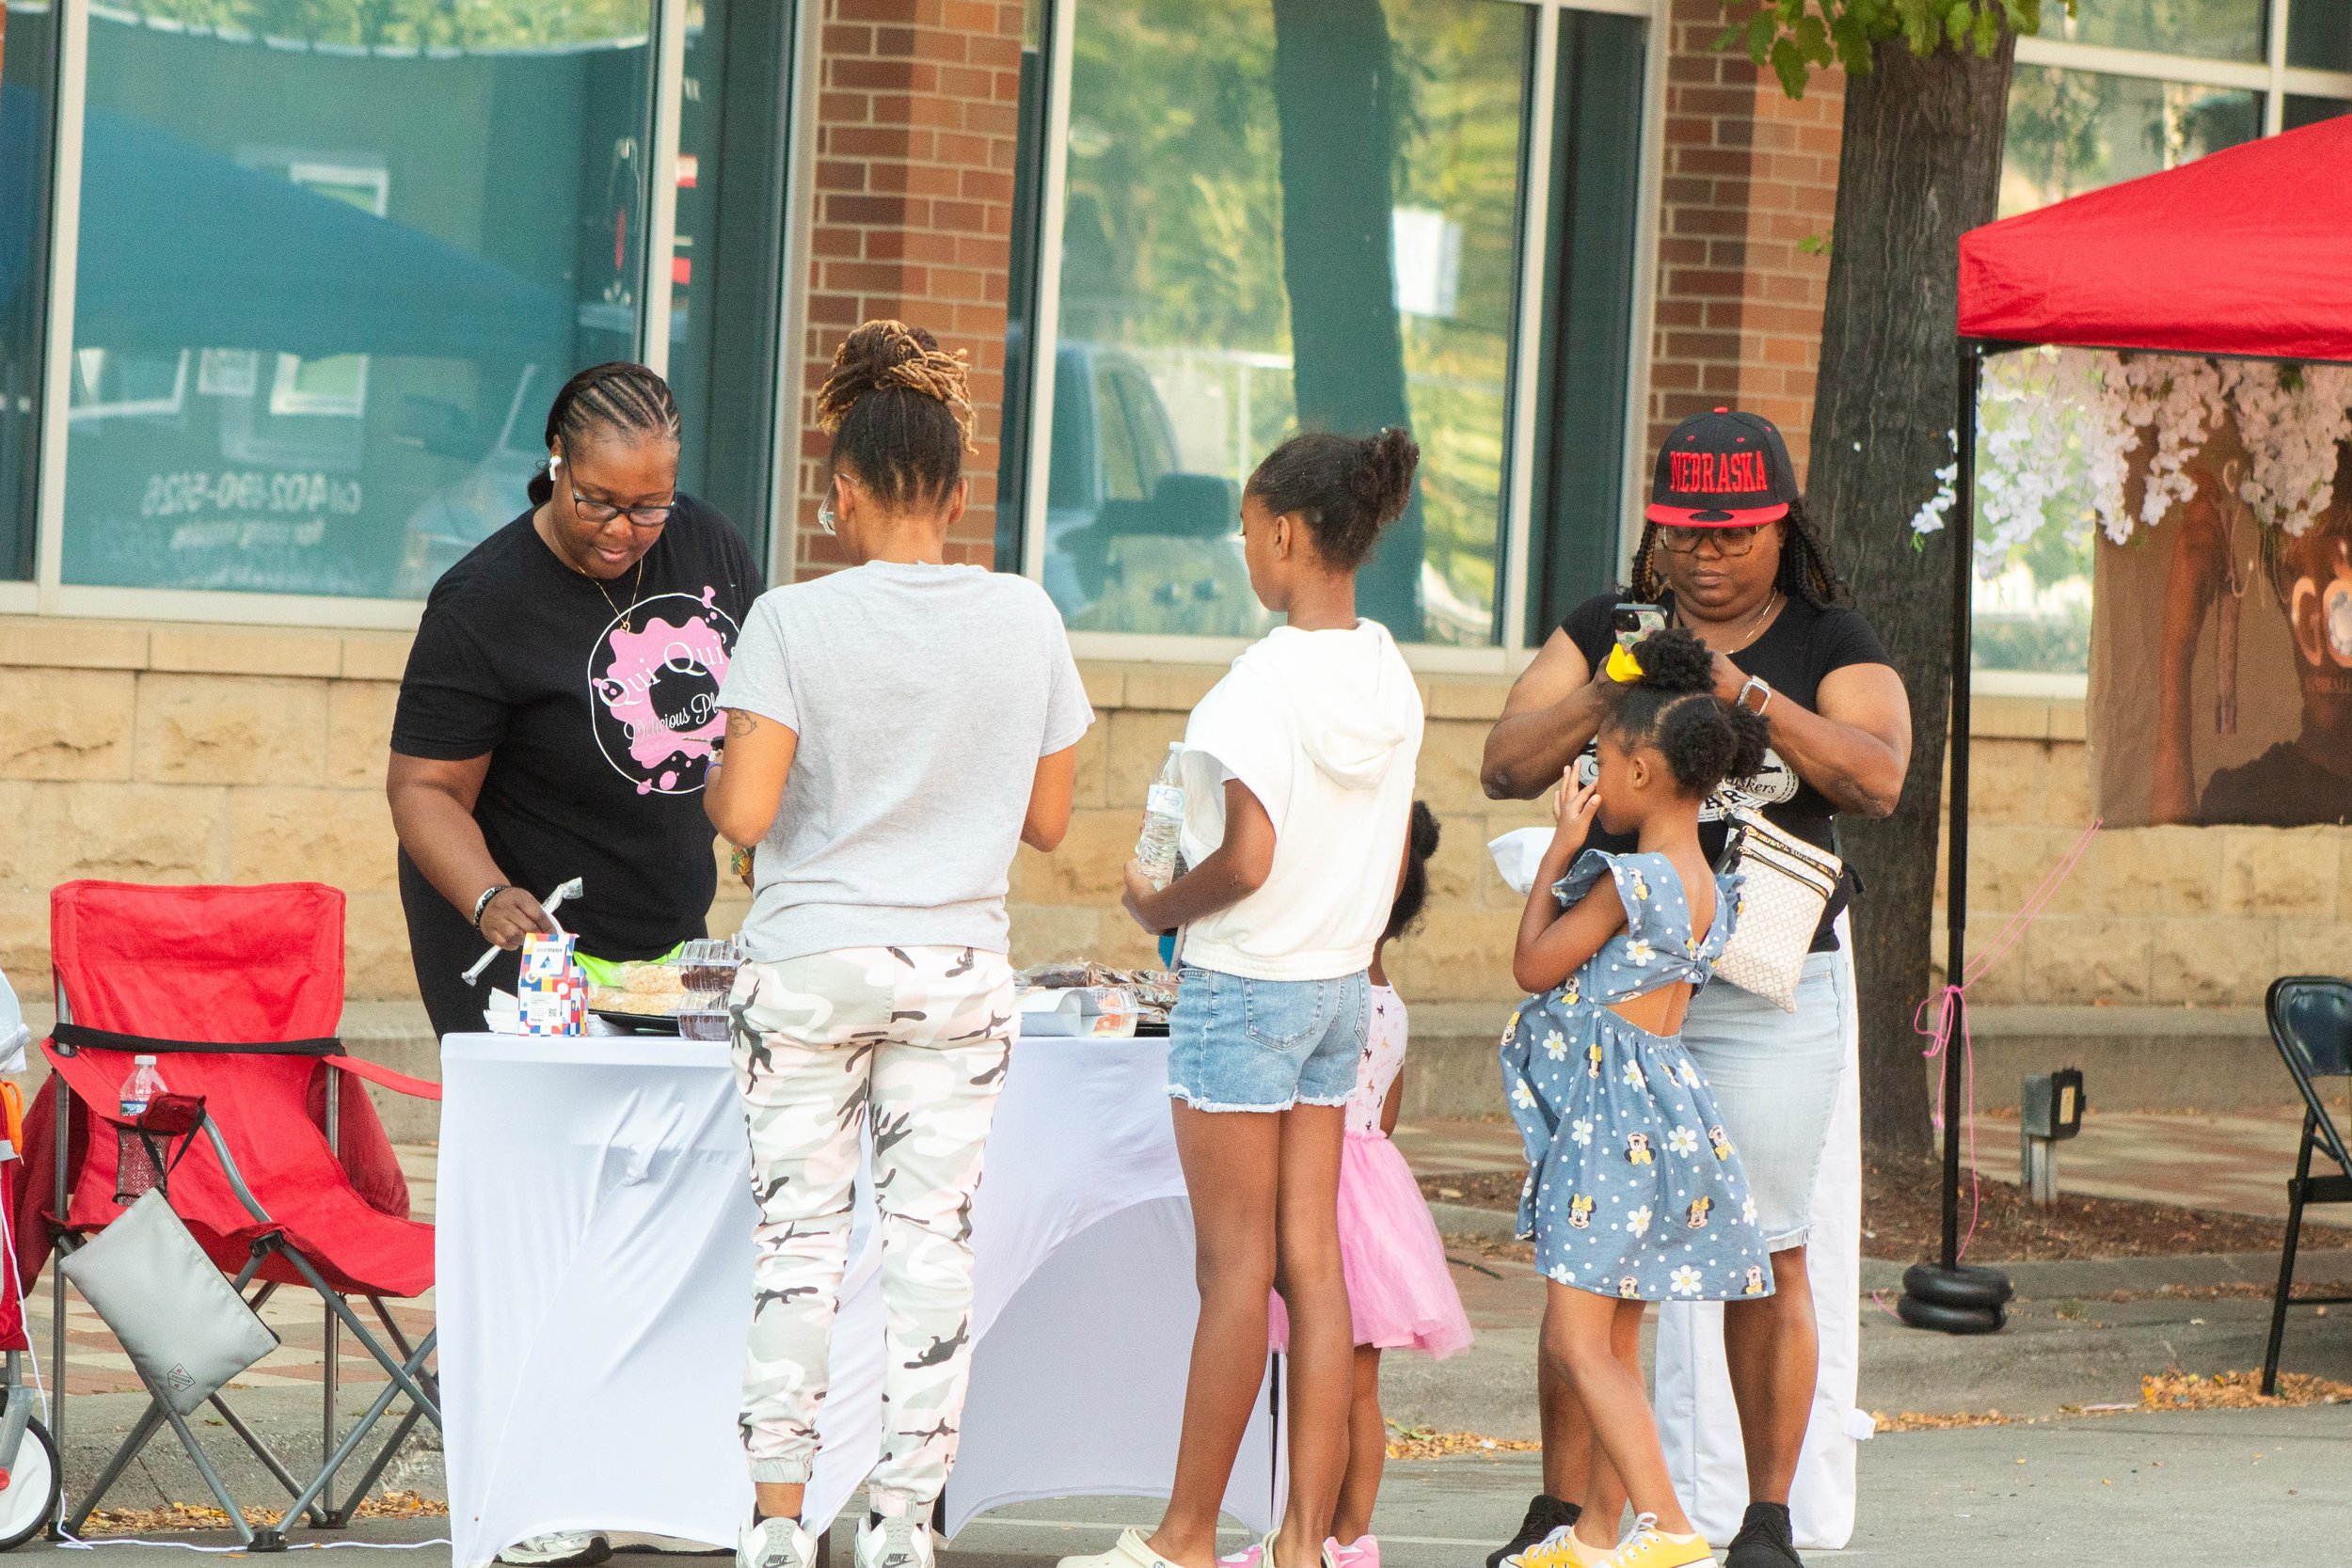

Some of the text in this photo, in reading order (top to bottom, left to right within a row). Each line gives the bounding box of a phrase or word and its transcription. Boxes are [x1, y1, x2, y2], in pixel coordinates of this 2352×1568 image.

[1670, 451, 1768, 493] NEBRASKA
[598, 658, 661, 707] Qui
[624, 706, 691, 750] Delicious
[768, 1554, 788, 1564] NIKE
[887, 1553, 909, 1562] NIKE
